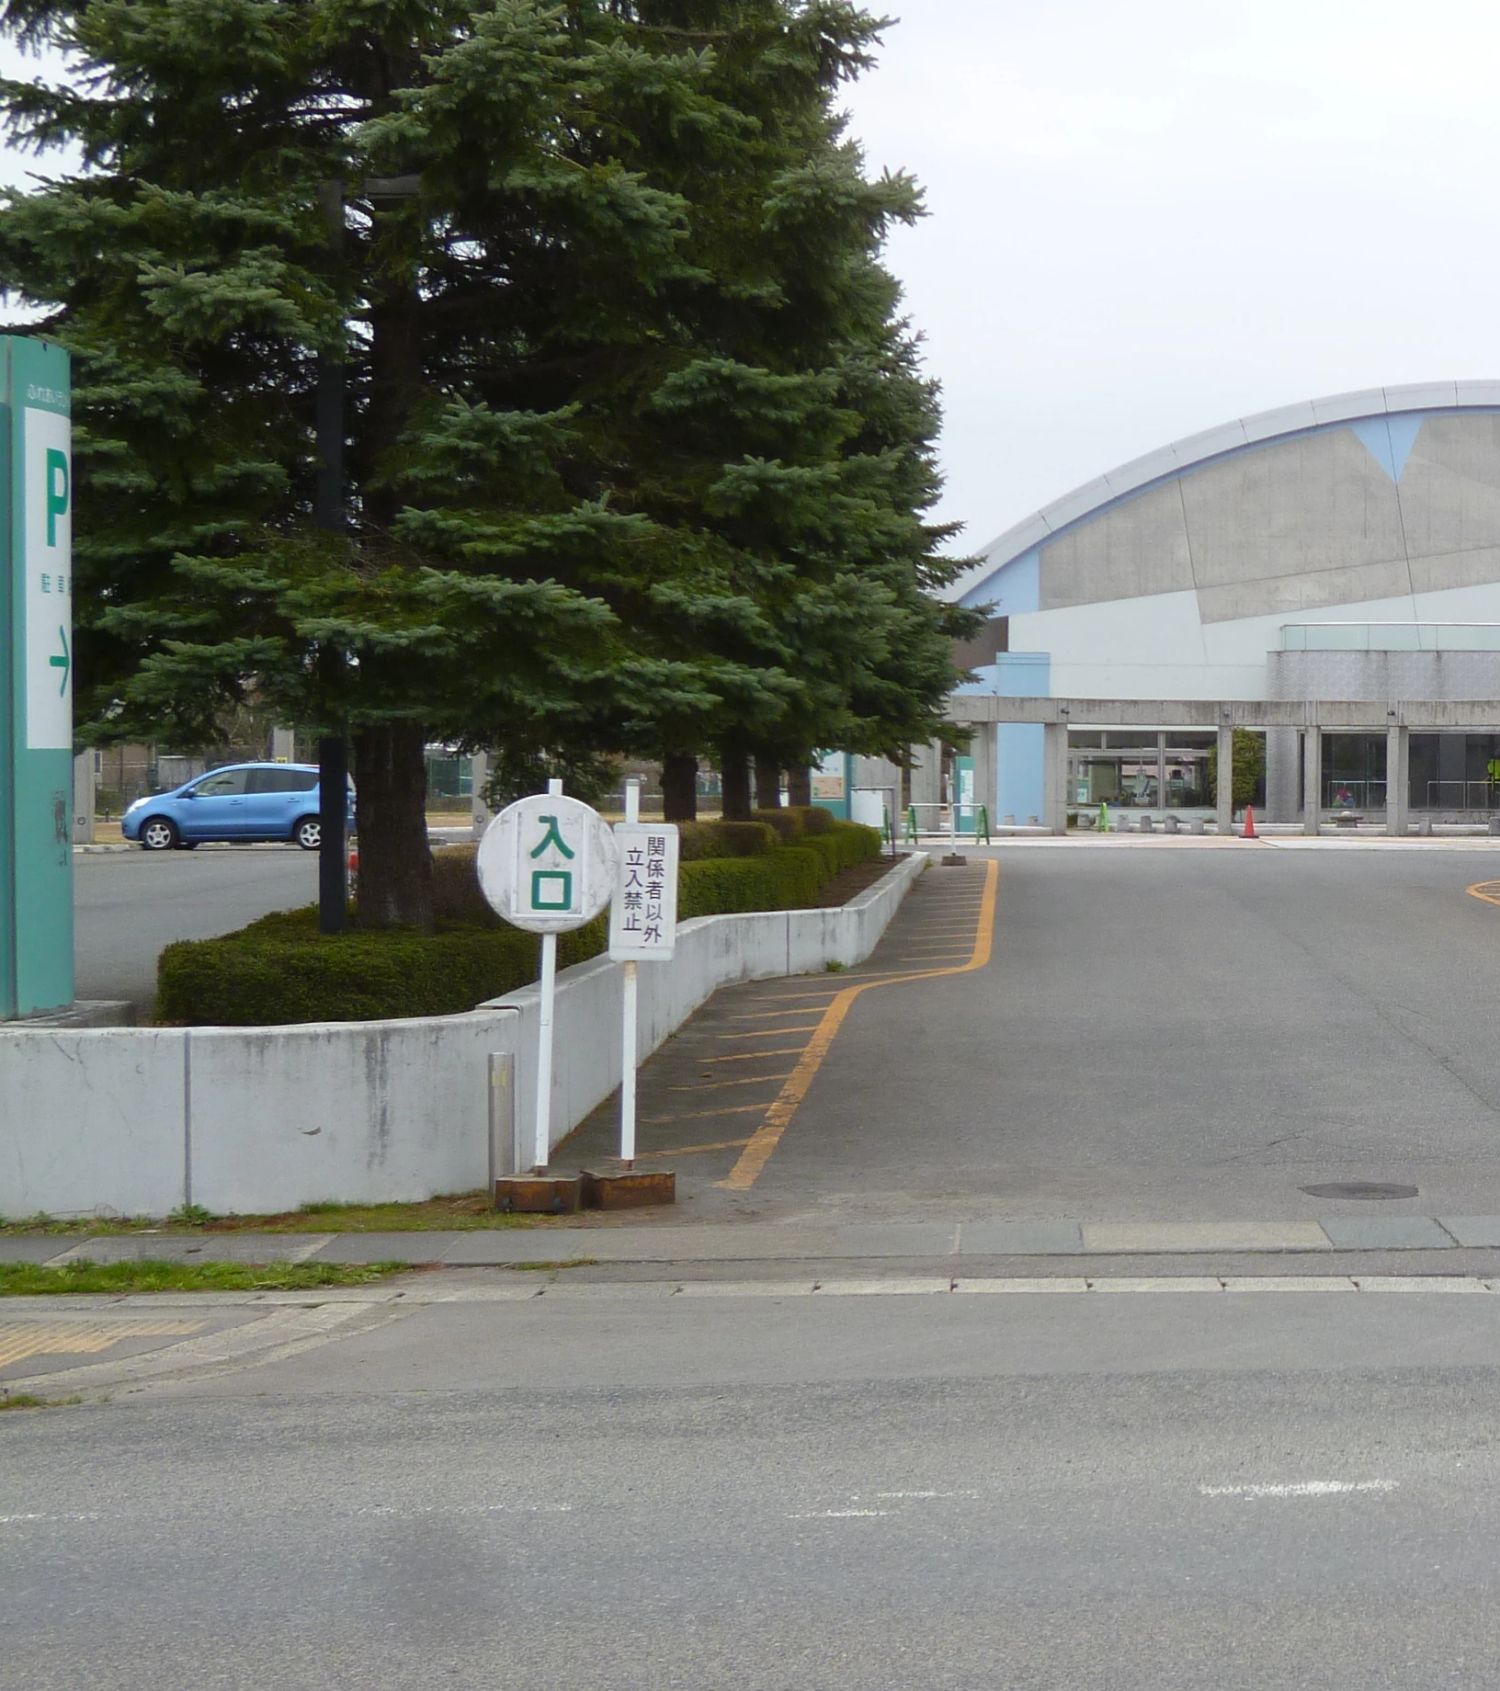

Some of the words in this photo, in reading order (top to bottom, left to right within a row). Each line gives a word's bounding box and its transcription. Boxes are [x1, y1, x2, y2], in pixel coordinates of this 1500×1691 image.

[46, 448, 69, 547] P
[530, 815, 575, 911] 入口
[622, 846, 644, 932] 立入禁止
[643, 836, 666, 944] 関係者以外
